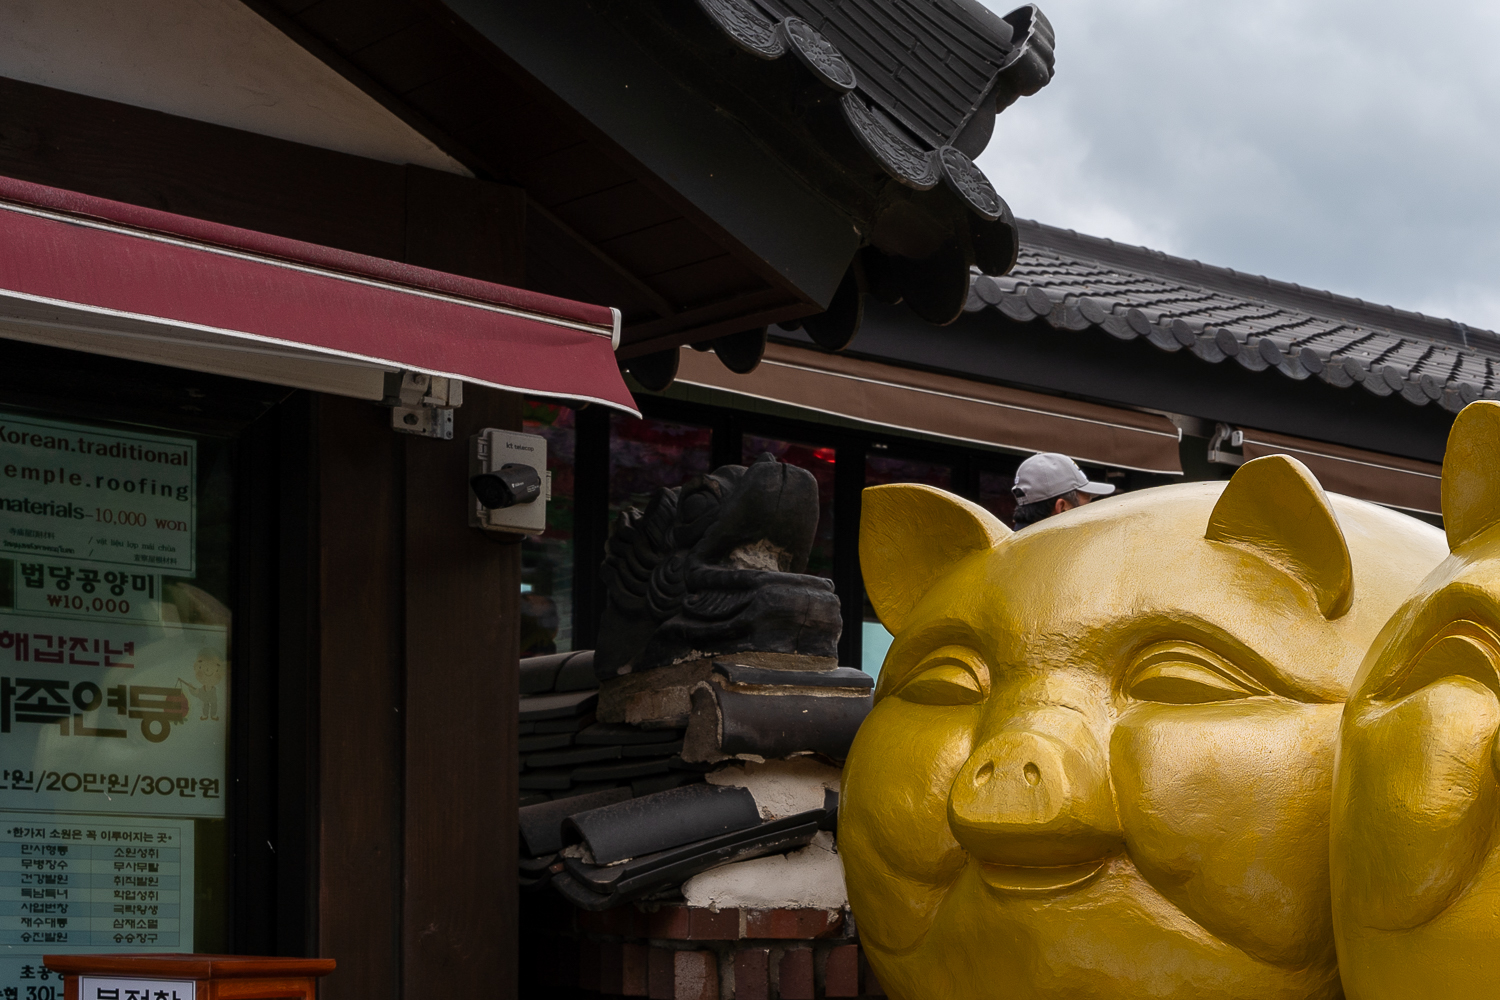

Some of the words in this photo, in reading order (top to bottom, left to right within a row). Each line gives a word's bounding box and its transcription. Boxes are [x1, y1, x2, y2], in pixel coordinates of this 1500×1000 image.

[155, 517, 188, 533] won
[21, 562, 154, 599] 법당공양미
[47, 594, 130, 614] ₩10,000
[50, 829, 82, 840] 소원은
[86, 830, 97, 840] 꼭
[101, 830, 154, 842] 이루어지는
